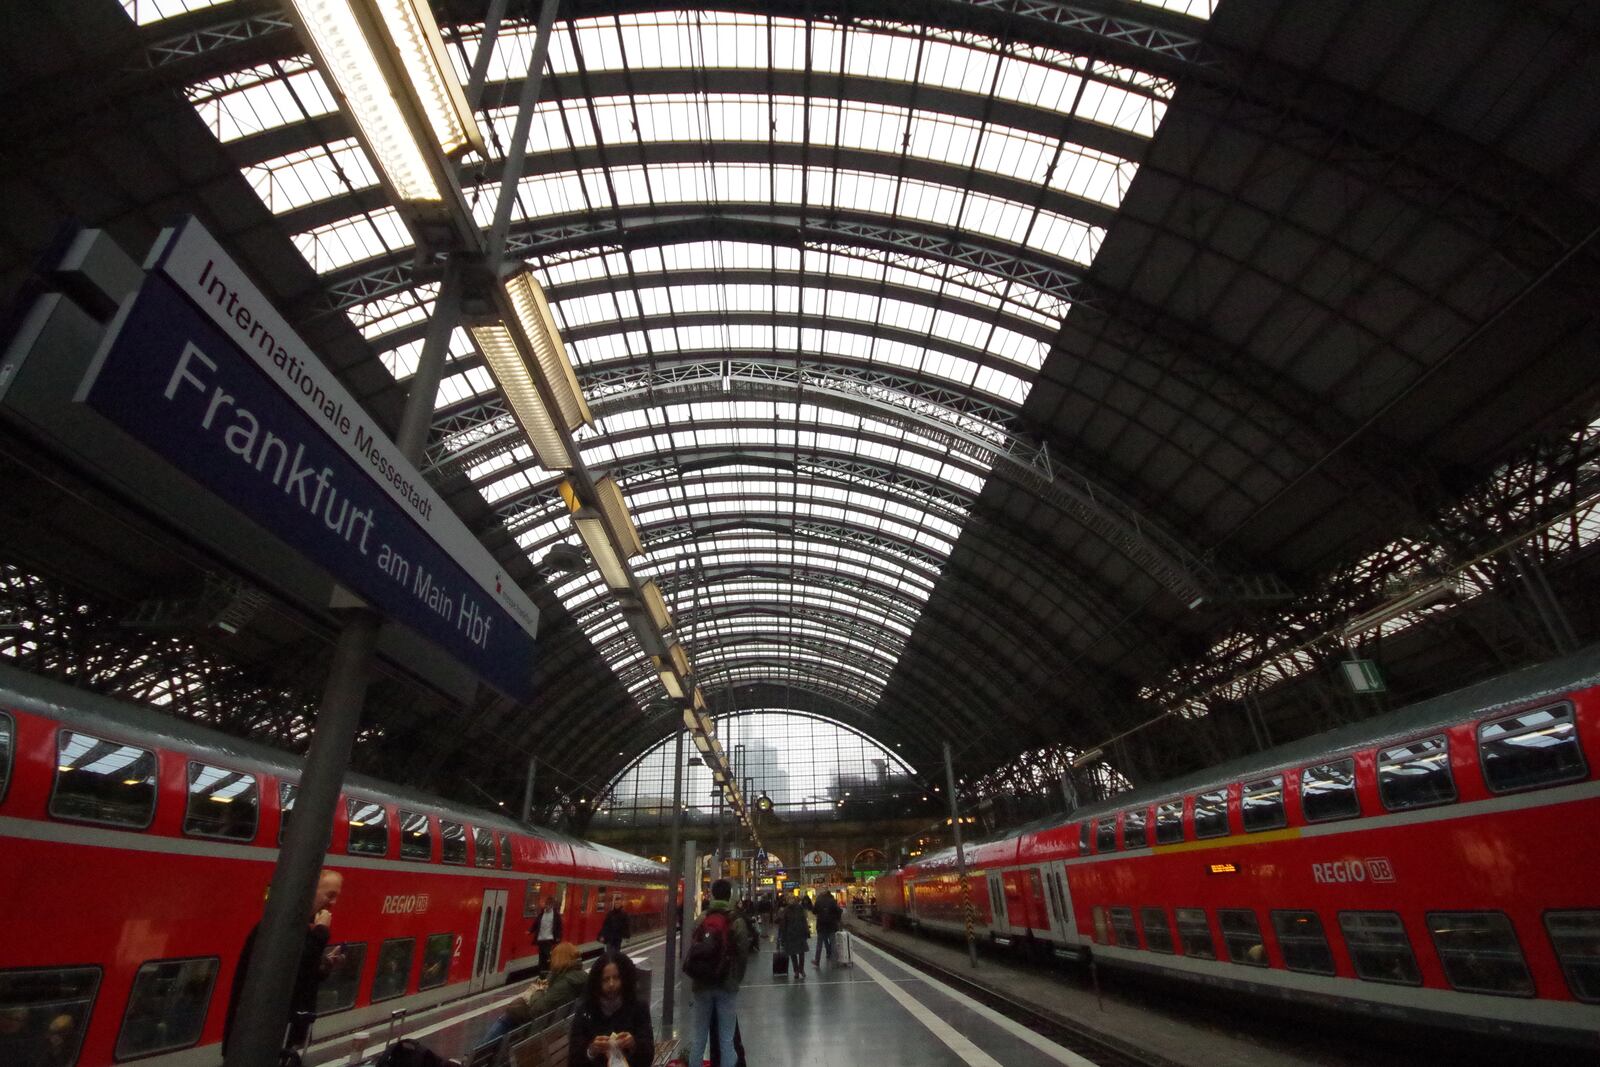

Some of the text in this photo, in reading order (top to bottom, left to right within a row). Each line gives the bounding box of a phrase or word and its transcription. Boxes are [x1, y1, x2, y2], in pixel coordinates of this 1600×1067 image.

[197, 259, 434, 521] Internationale Messestadt
[164, 340, 375, 555] Frankfurt
[377, 543, 409, 586] am
[412, 565, 453, 621] Main
[457, 592, 492, 650] Hbf
[1312, 859, 1393, 883] REGIO DB
[381, 895, 415, 914] REGIO
[453, 935, 463, 957] 2
